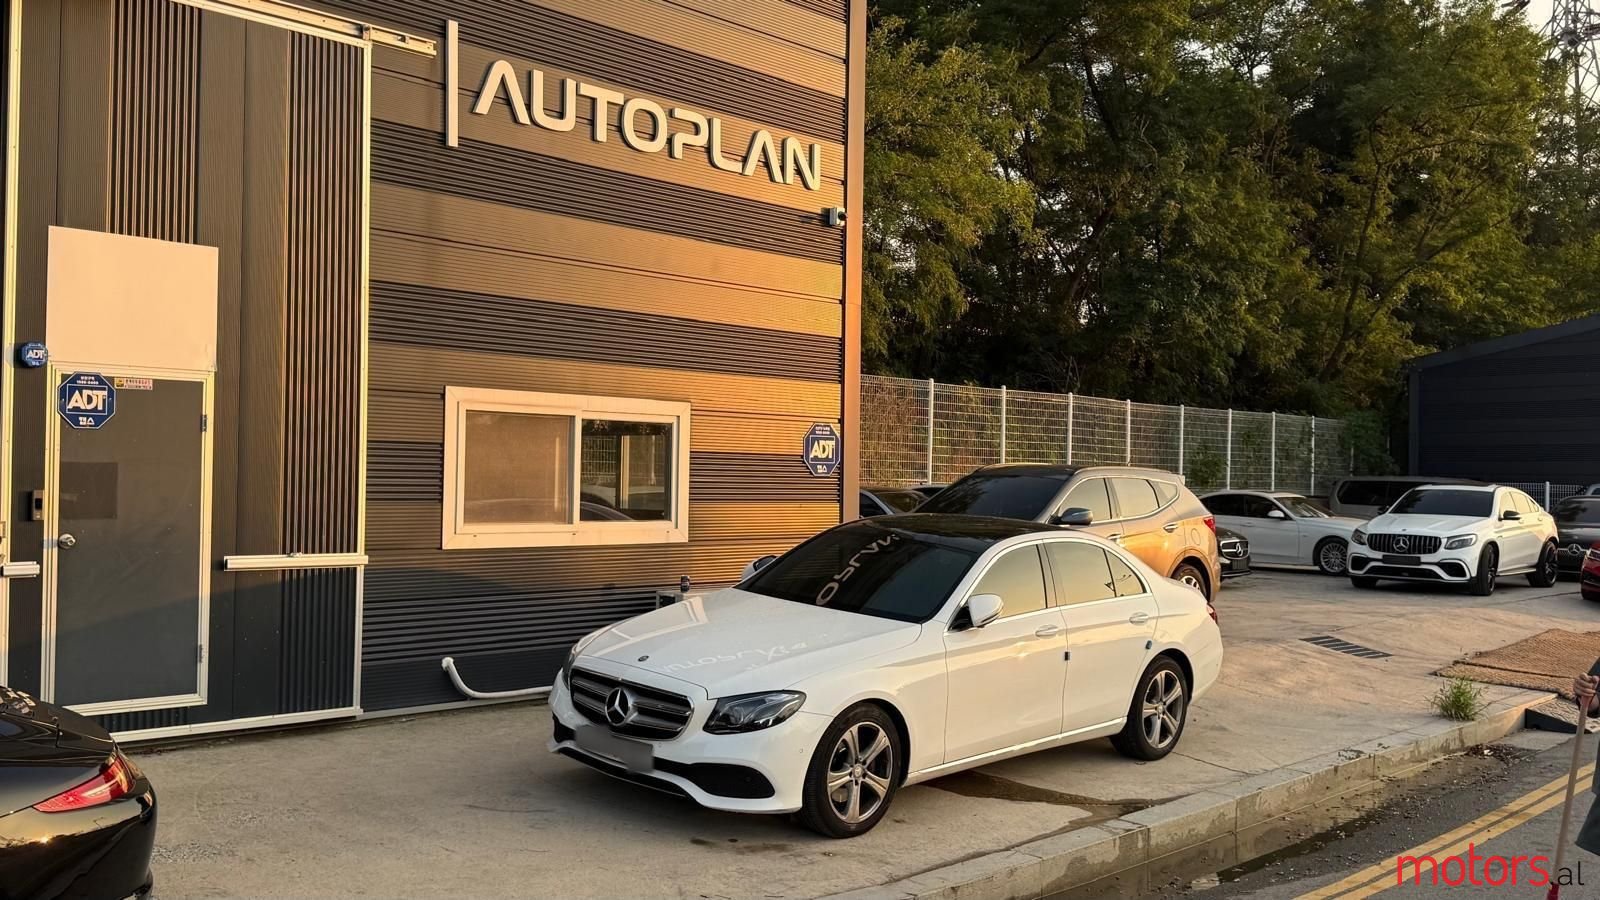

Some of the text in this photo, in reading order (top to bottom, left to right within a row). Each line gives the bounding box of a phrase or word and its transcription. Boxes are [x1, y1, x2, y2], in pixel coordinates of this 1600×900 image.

[472, 60, 821, 191] AUTOPLAN
[26, 349, 45, 359] ADT
[67, 389, 107, 410] ADT
[810, 440, 835, 458] ADT
